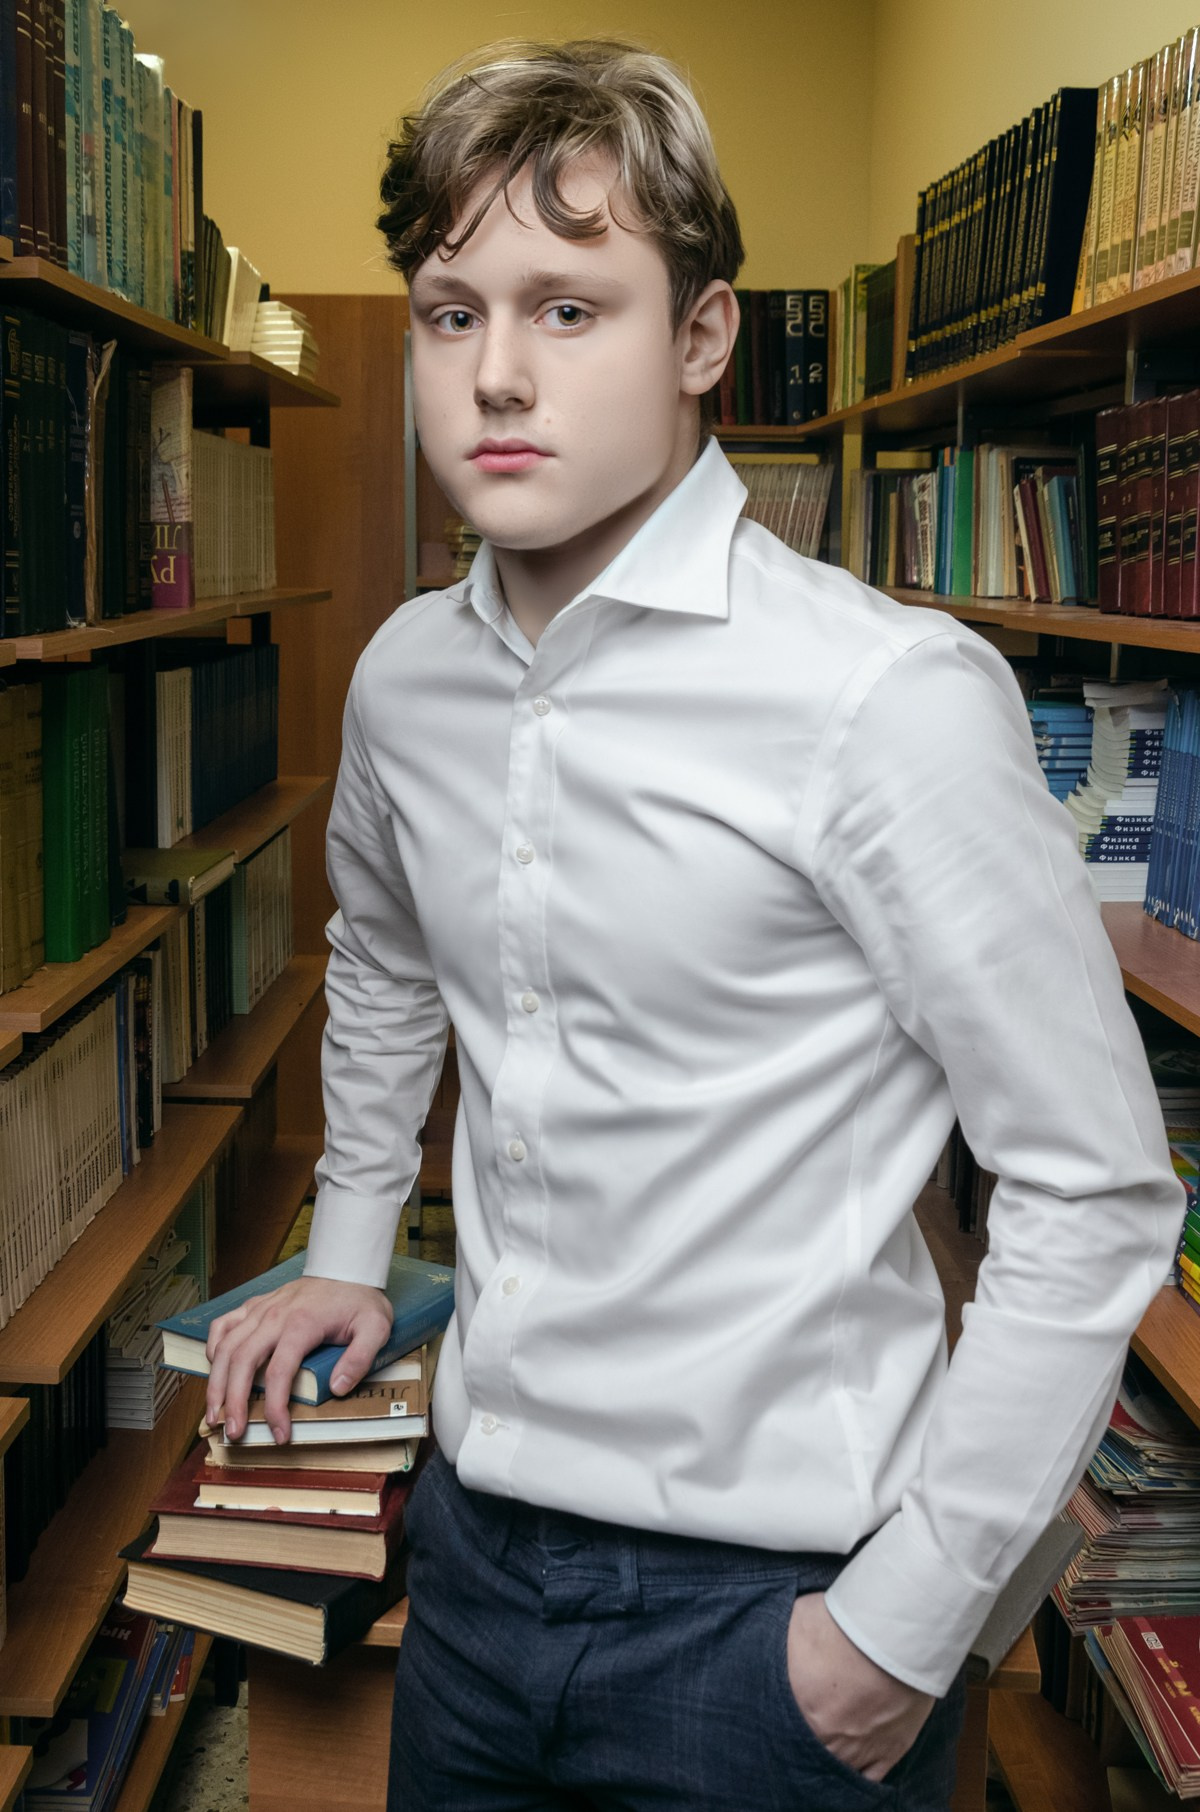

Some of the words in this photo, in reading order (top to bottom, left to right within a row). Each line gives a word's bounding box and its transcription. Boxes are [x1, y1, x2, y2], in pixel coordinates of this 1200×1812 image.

[101, 10, 110, 70] ДЕТЕЙ
[72, 64, 80, 104] ДЛЯ
[103, 77, 111, 114] ДЛЯ
[1183, 106, 1199, 203] ШКОЛЬНАЯ
[73, 114, 82, 273] ЭНЦИКЛОПЕДИЯ
[103, 124, 113, 279] ЭНЦИКЛОПЕДИЯ
[120, 141, 128, 290] ЭНЦИКЛОПЕДИЯ
[790, 364, 800, 379] 1
[808, 362, 823, 377] 2
